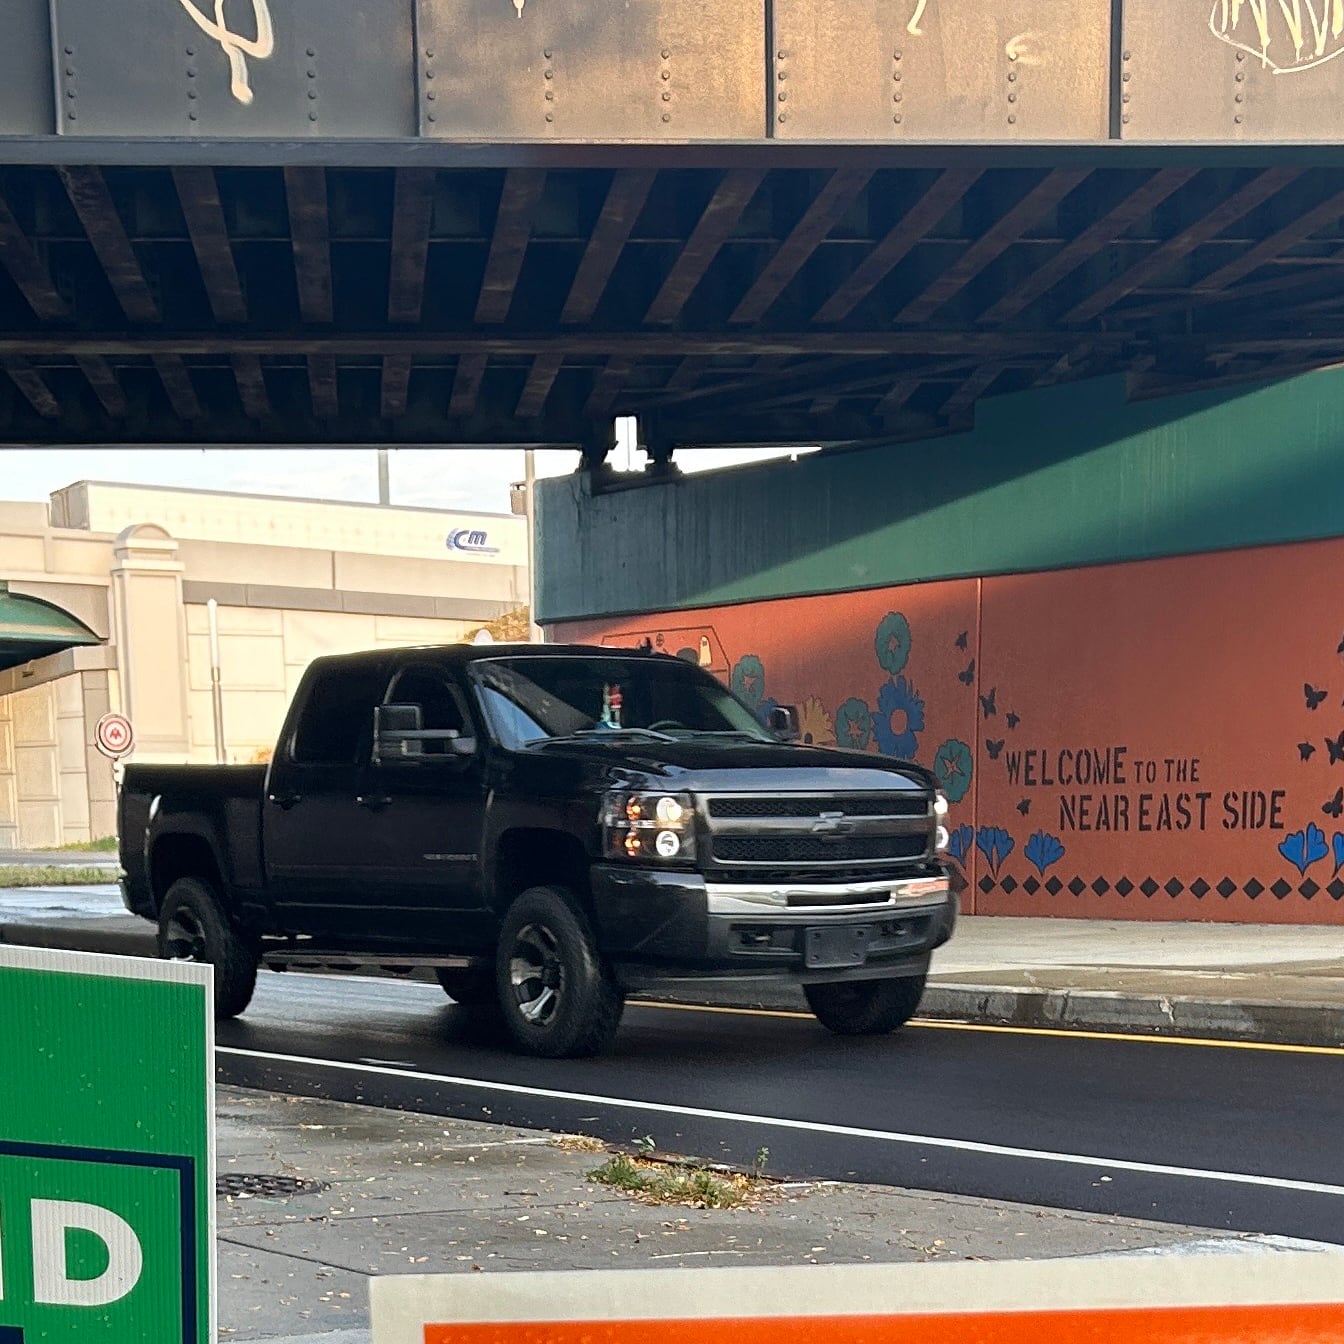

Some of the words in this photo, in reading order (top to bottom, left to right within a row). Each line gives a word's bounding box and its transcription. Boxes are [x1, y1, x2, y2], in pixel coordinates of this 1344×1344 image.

[1006, 747, 1127, 786] WELCOME
[1134, 760, 1156, 784] TO
[1164, 758, 1200, 783] THE
[1059, 794, 1130, 831] NEAR
[1138, 792, 1212, 831] EAST
[1222, 790, 1286, 831] SIDE
